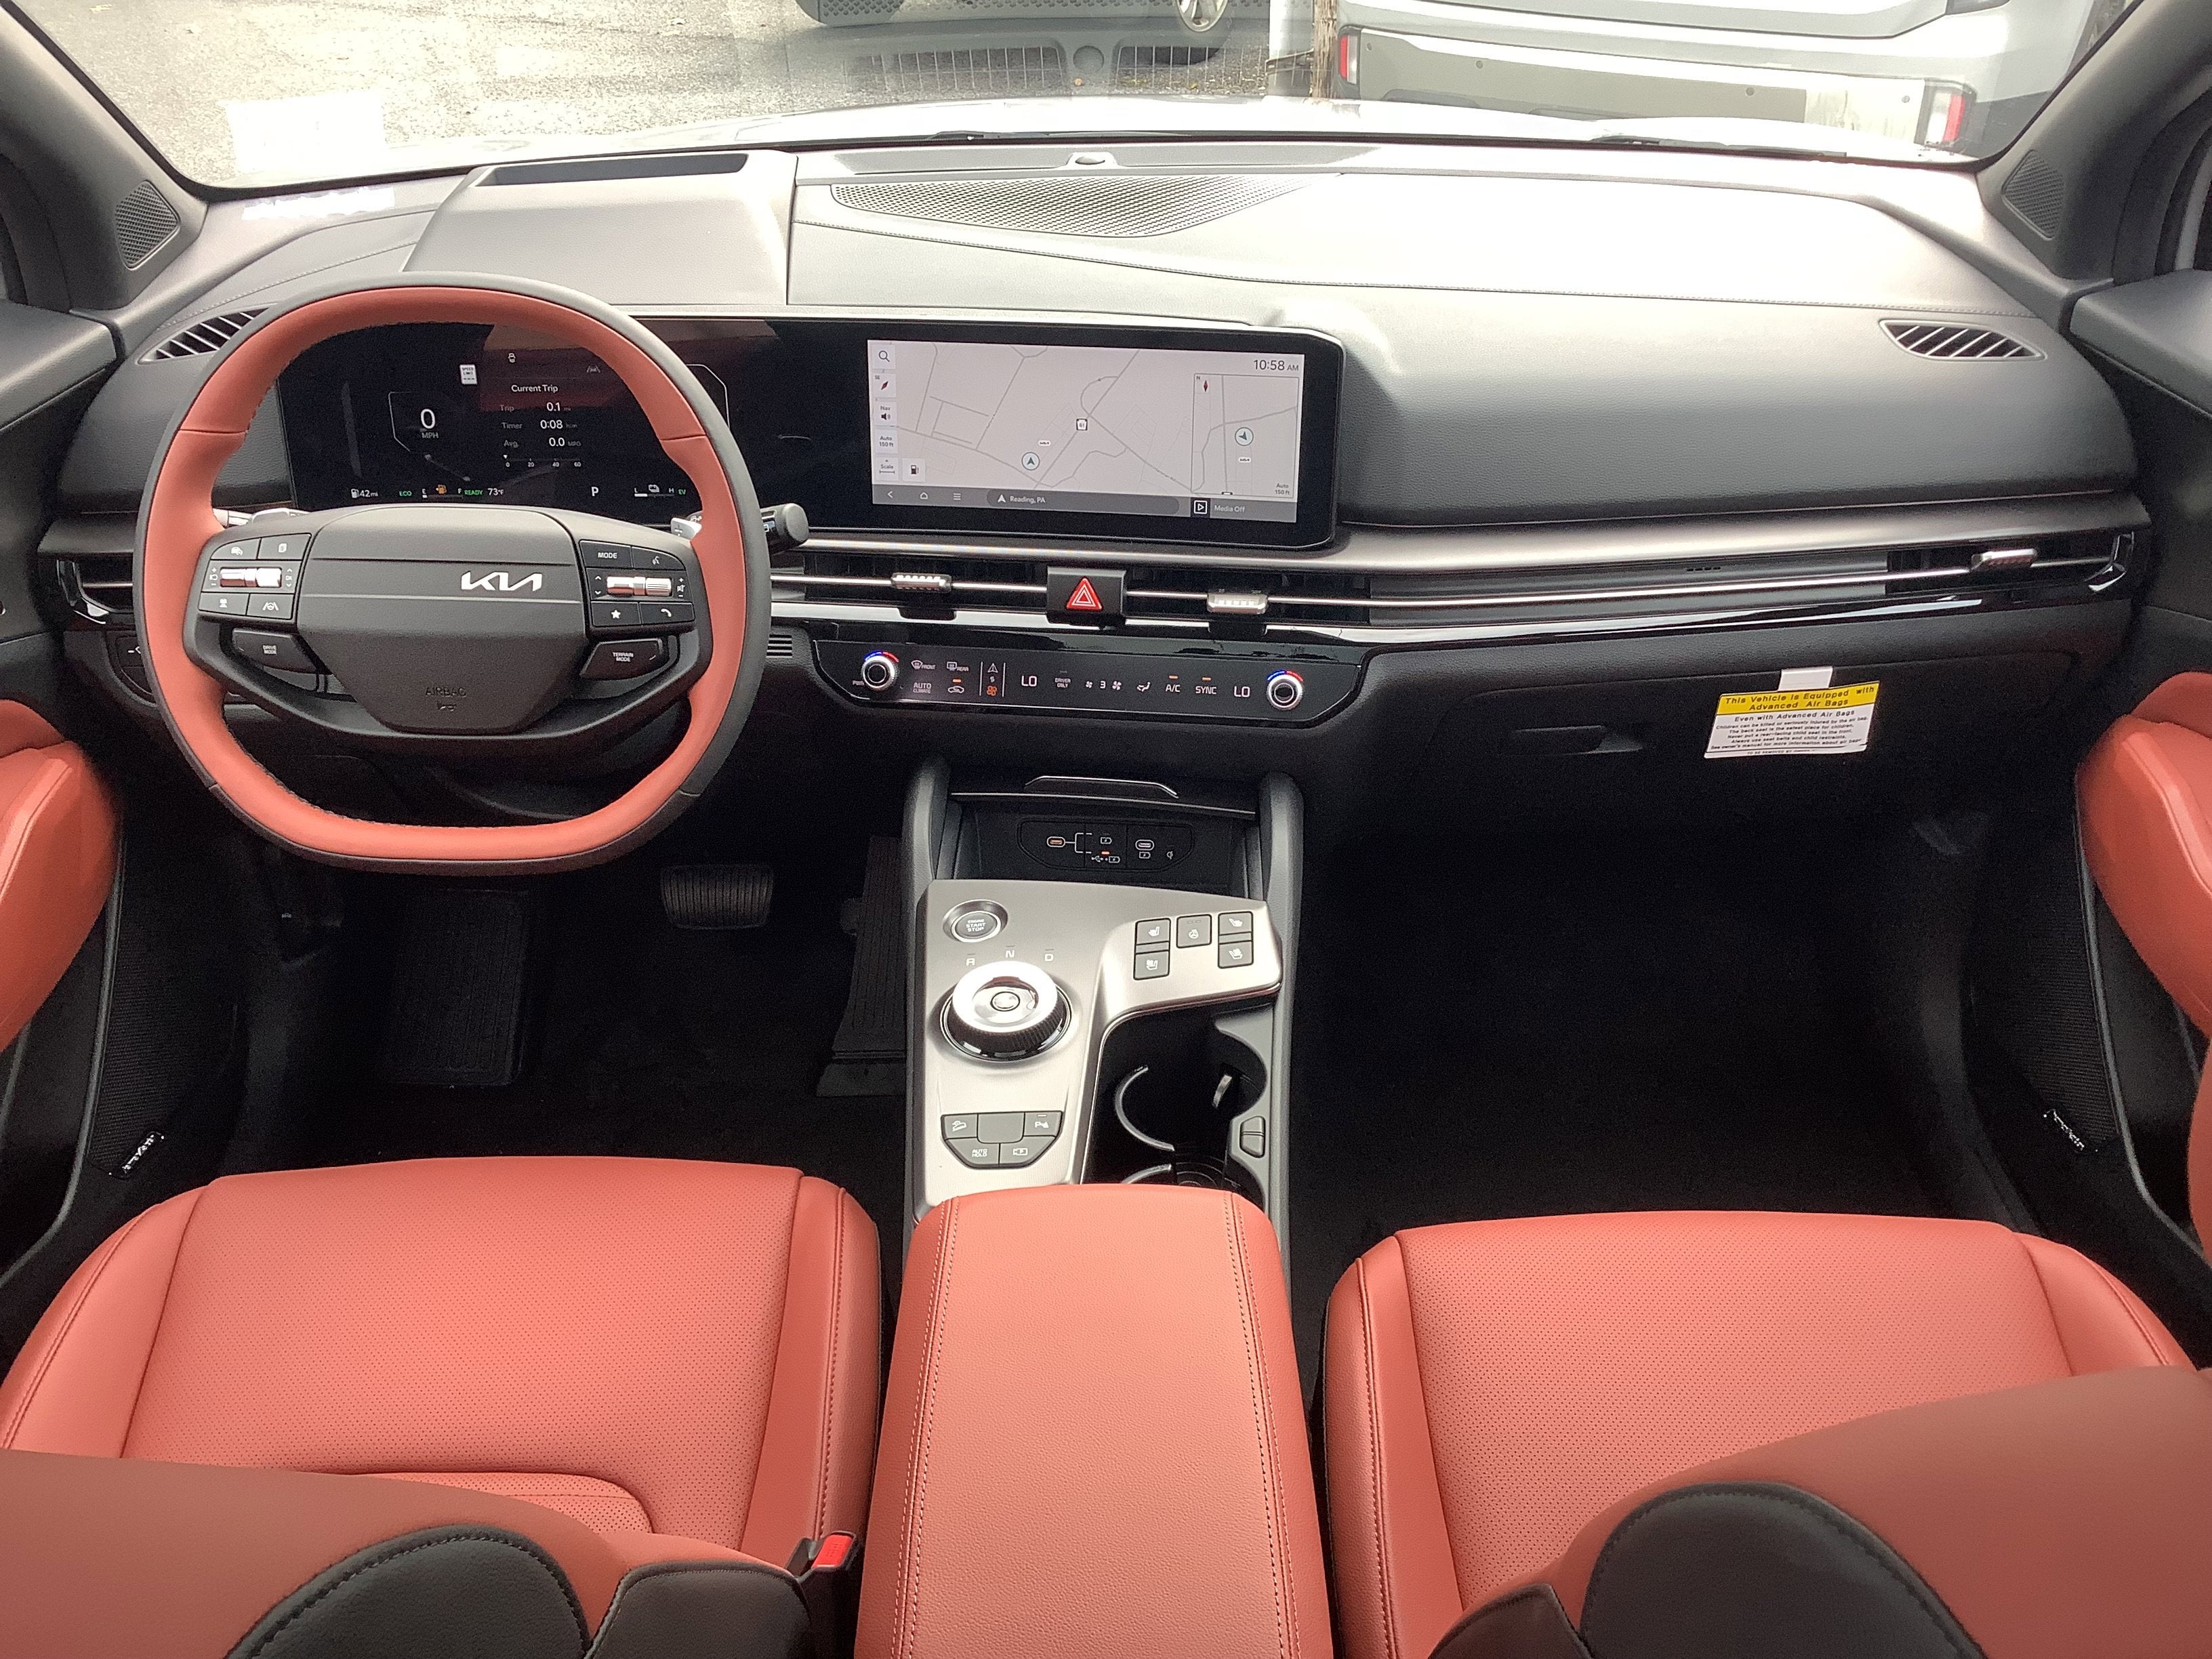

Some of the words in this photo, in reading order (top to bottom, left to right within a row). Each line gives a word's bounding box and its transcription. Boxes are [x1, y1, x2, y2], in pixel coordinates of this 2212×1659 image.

[1254, 359, 1285, 371] 10:58
[511, 384, 541, 393] Current
[542, 384, 558, 393] Trip
[546, 402, 561, 411] 0.1
[420, 408, 436, 429] 0
[540, 419, 563, 429] 0:08
[548, 438, 565, 447] 0.0
[591, 486, 599, 497] P
[1010, 496, 1036, 504] Reading,
[1214, 504, 1233, 513] Media
[1234, 505, 1246, 513] Off
[1021, 675, 1038, 687] LO
[1100, 680, 1106, 689] 3
[425, 686, 467, 698] AIRBAG
[1165, 684, 1181, 693] A/C
[1195, 685, 1217, 695] SYNC
[1234, 686, 1251, 698] LO
[1751, 695, 1786, 703] Vehicle
[1803, 689, 1850, 700] Equipped
[1856, 686, 1875, 695] with
[1749, 702, 1799, 712] Advanced
[1805, 699, 1822, 708] Air
[1825, 698, 1849, 707] Bags
[1005, 949, 1015, 958] N
[1044, 954, 1054, 962] D
[966, 958, 976, 966] R
